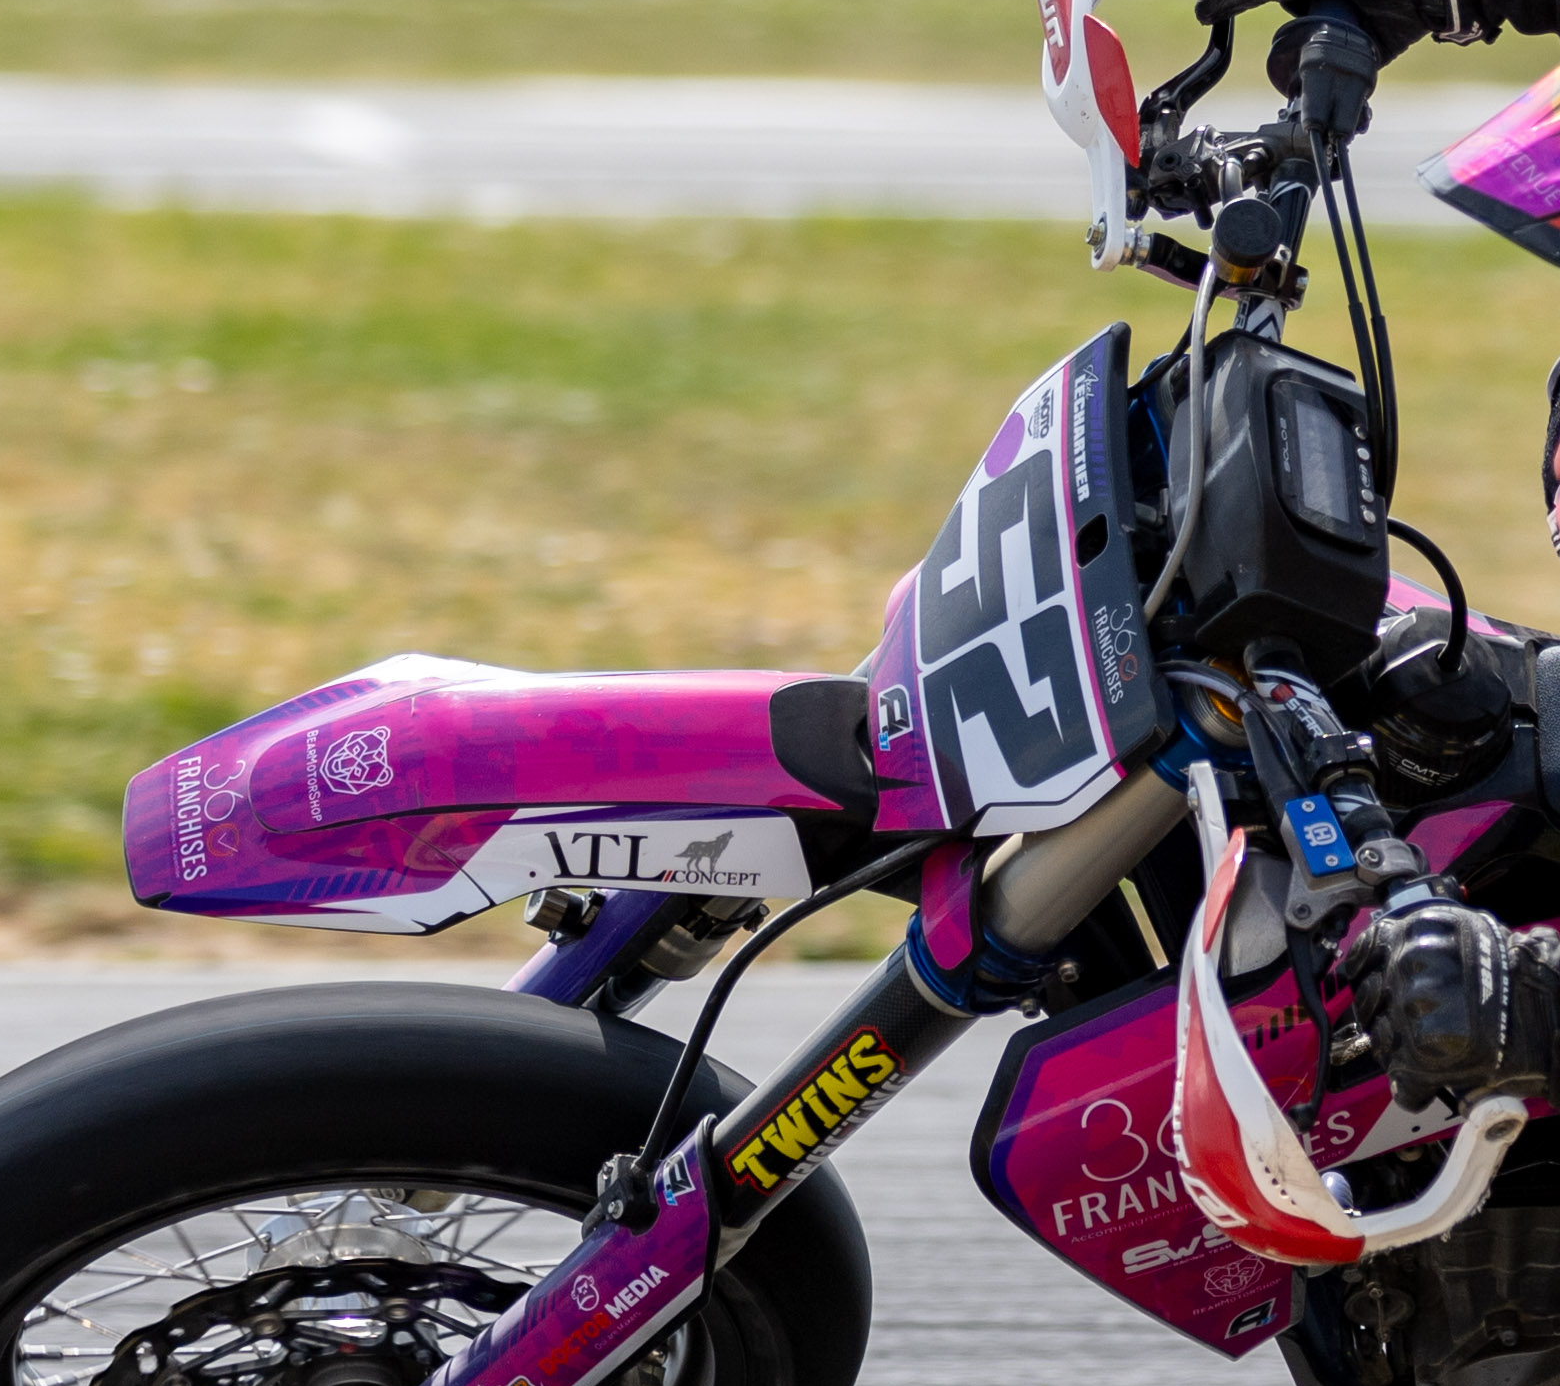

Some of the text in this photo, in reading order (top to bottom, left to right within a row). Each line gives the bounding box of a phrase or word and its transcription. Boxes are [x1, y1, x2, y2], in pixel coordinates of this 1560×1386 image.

[1073, 374, 1090, 502] LECHARTIER
[919, 449, 1100, 789] 52
[1094, 605, 1124, 704] FRANCHISES
[1285, 697, 1323, 737] SCAR
[177, 755, 208, 881] FRANCHISES
[305, 729, 323, 822] BEARMOTORSHOP
[1399, 759, 1441, 778] CMT
[732, 1034, 895, 1190] TWINS
[604, 1265, 670, 1320] MEDIA
